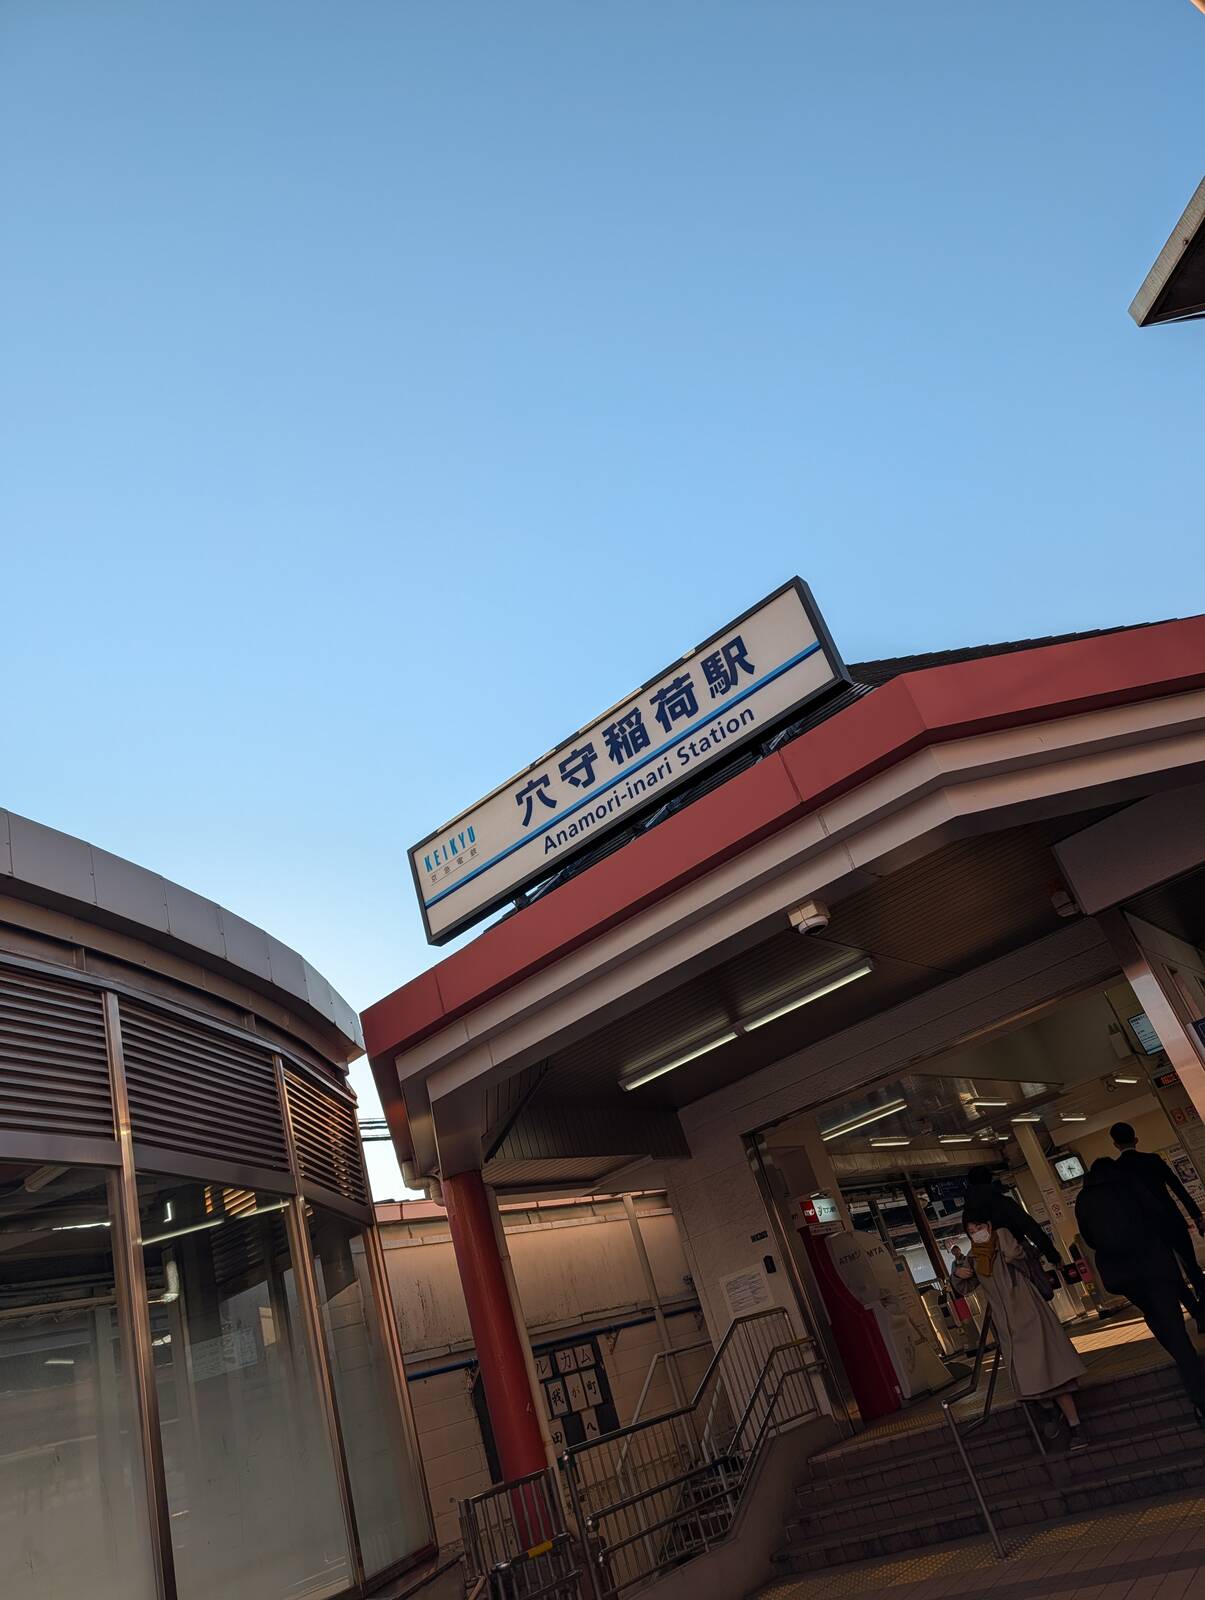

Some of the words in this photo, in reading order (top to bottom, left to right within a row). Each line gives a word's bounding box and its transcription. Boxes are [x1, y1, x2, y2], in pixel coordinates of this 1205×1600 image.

[515, 634, 756, 828] 穴守稲荷駅
[544, 756, 672, 855] Anamori-inari
[677, 707, 755, 765] Station
[424, 825, 476, 872] KEIKYU
